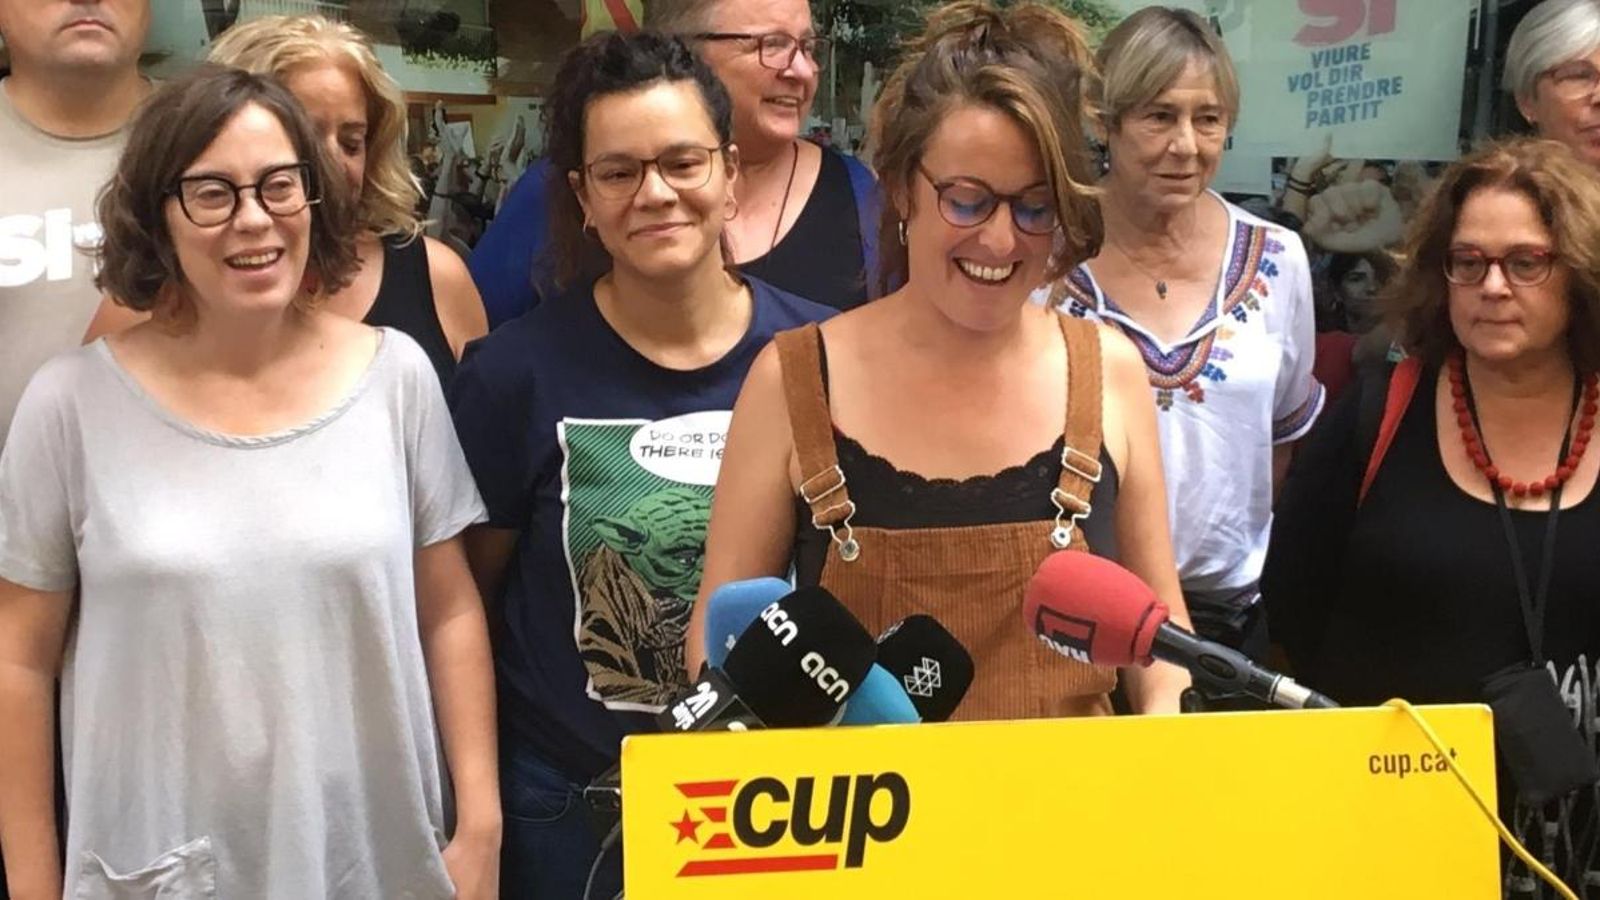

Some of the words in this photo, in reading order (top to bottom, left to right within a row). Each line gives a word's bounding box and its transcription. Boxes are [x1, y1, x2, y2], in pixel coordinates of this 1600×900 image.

[1311, 43, 1371, 68] VIURE
[1287, 71, 1324, 93] VOL
[1328, 63, 1363, 86] DIR
[1306, 76, 1403, 108] PRENDRE
[1304, 100, 1383, 129] PARTIT
[640, 445, 703, 458] THERE
[650, 430, 674, 442] DO
[680, 431, 704, 444] OR
[761, 601, 799, 646] acn
[800, 651, 850, 703] acn
[733, 772, 911, 869] cup
